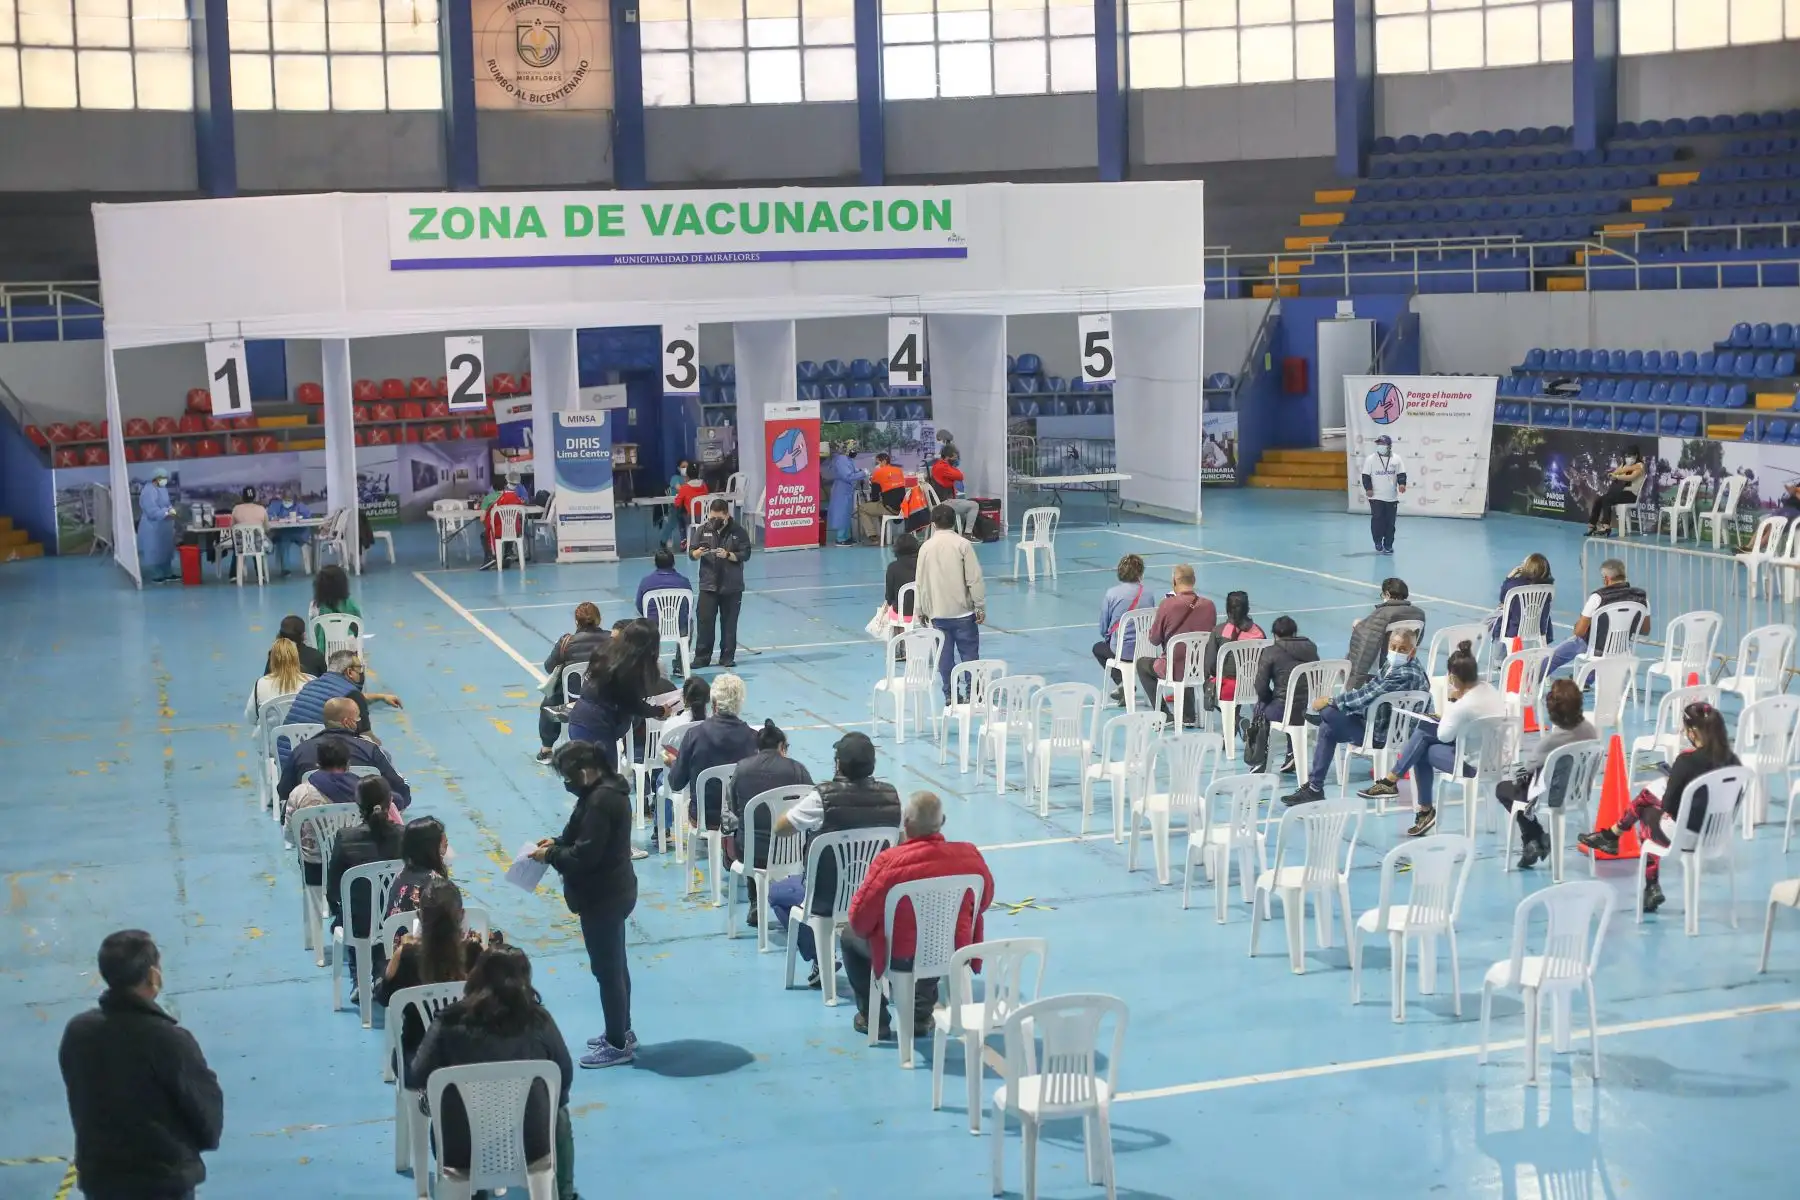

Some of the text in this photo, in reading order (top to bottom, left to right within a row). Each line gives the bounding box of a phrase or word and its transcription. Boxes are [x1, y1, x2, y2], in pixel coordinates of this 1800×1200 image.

[487, 58, 589, 104] RUMBO AL BICENTENARIO
[408, 199, 952, 241] ZONA DE VACUNACION
[614, 253, 760, 264] MUNICIPALIDAD DE MIRAFLORES
[889, 333, 922, 381] 4
[1084, 331, 1113, 378] 5
[665, 339, 697, 389] 3
[214, 357, 241, 409] 1
[450, 353, 484, 403] 2
[1407, 390, 1472, 400] Pongo el hombro
[1405, 401, 1420, 410] por
[567, 414, 596, 423] MINSA
[566, 437, 600, 449] DIRIS
[557, 449, 610, 459] Lima Centro
[778, 484, 805, 496] Pongo
[768, 494, 813, 505] el hombro
[767, 503, 816, 519] por el Perú
